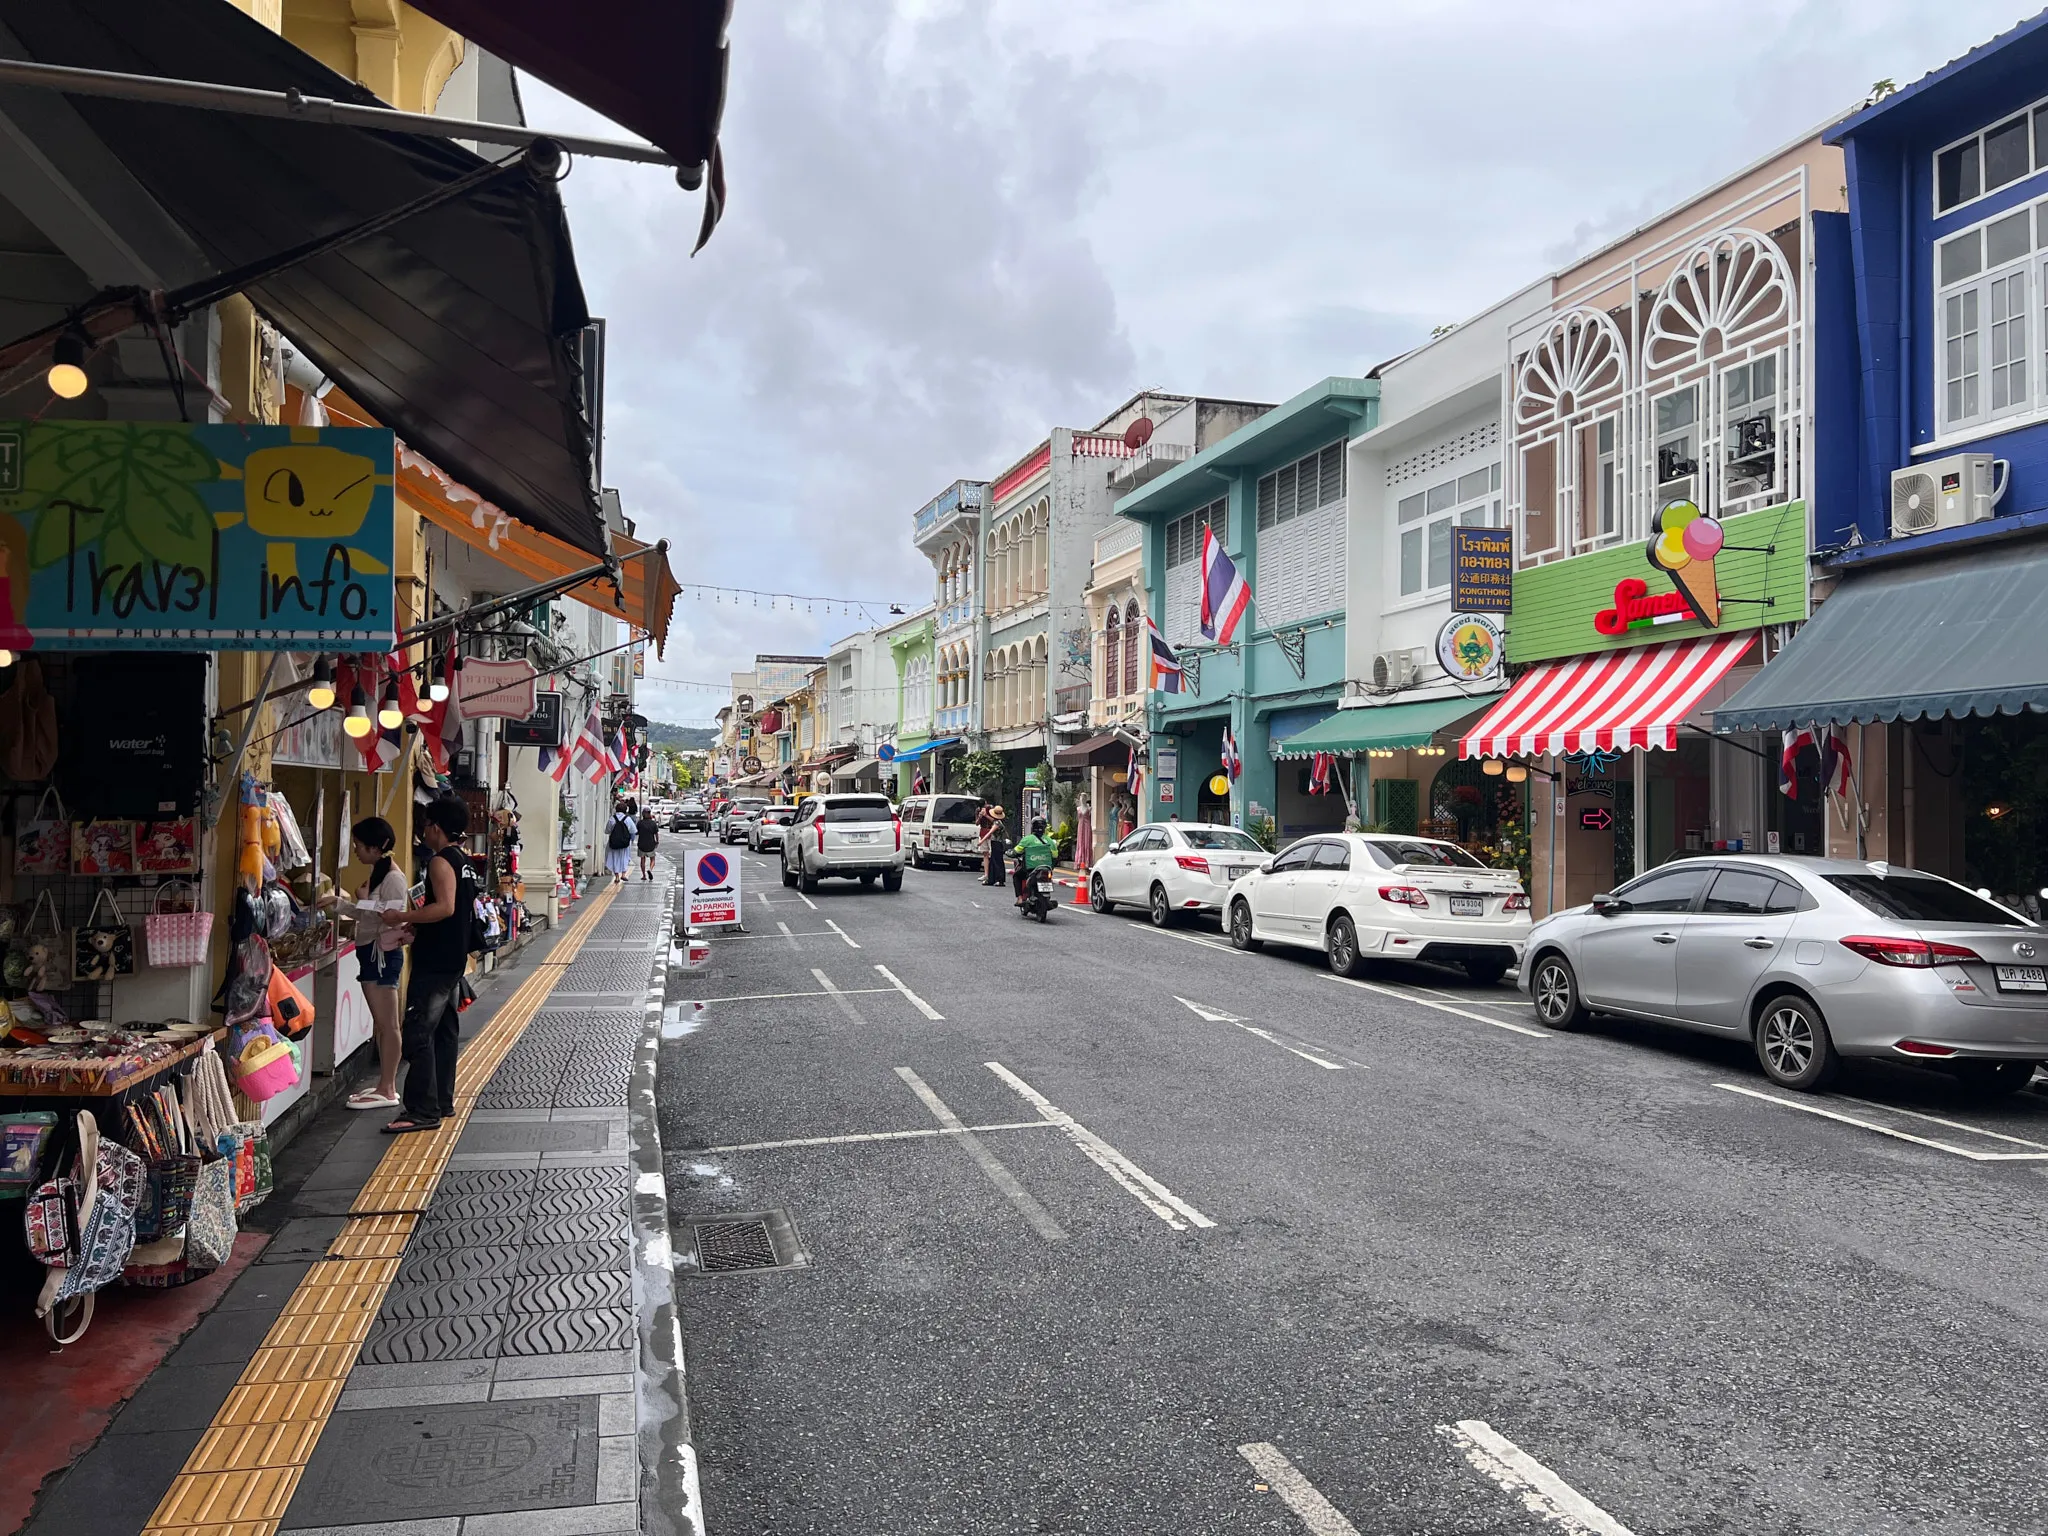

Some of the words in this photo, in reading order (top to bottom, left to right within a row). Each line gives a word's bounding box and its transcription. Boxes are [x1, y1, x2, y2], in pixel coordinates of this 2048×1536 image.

[1459, 534, 1511, 553] โรงพิมพ์
[1459, 556, 1511, 569] กองทอง
[260, 543, 378, 621] info.
[1459, 587, 1511, 597] KONGTHONG
[1459, 597, 1511, 606] PRINTING
[1448, 616, 1471, 636] weed
[1474, 617, 1498, 637] world
[68, 628, 93, 638] BY
[116, 628, 214, 639] PHUKET
[236, 629, 296, 639] NEXT
[318, 630, 372, 640] EXIT
[109, 738, 153, 749] water
[1567, 776, 1614, 790] Welcome
[703, 902, 735, 910] PARKING
[2020, 969, 2043, 981] 2488
